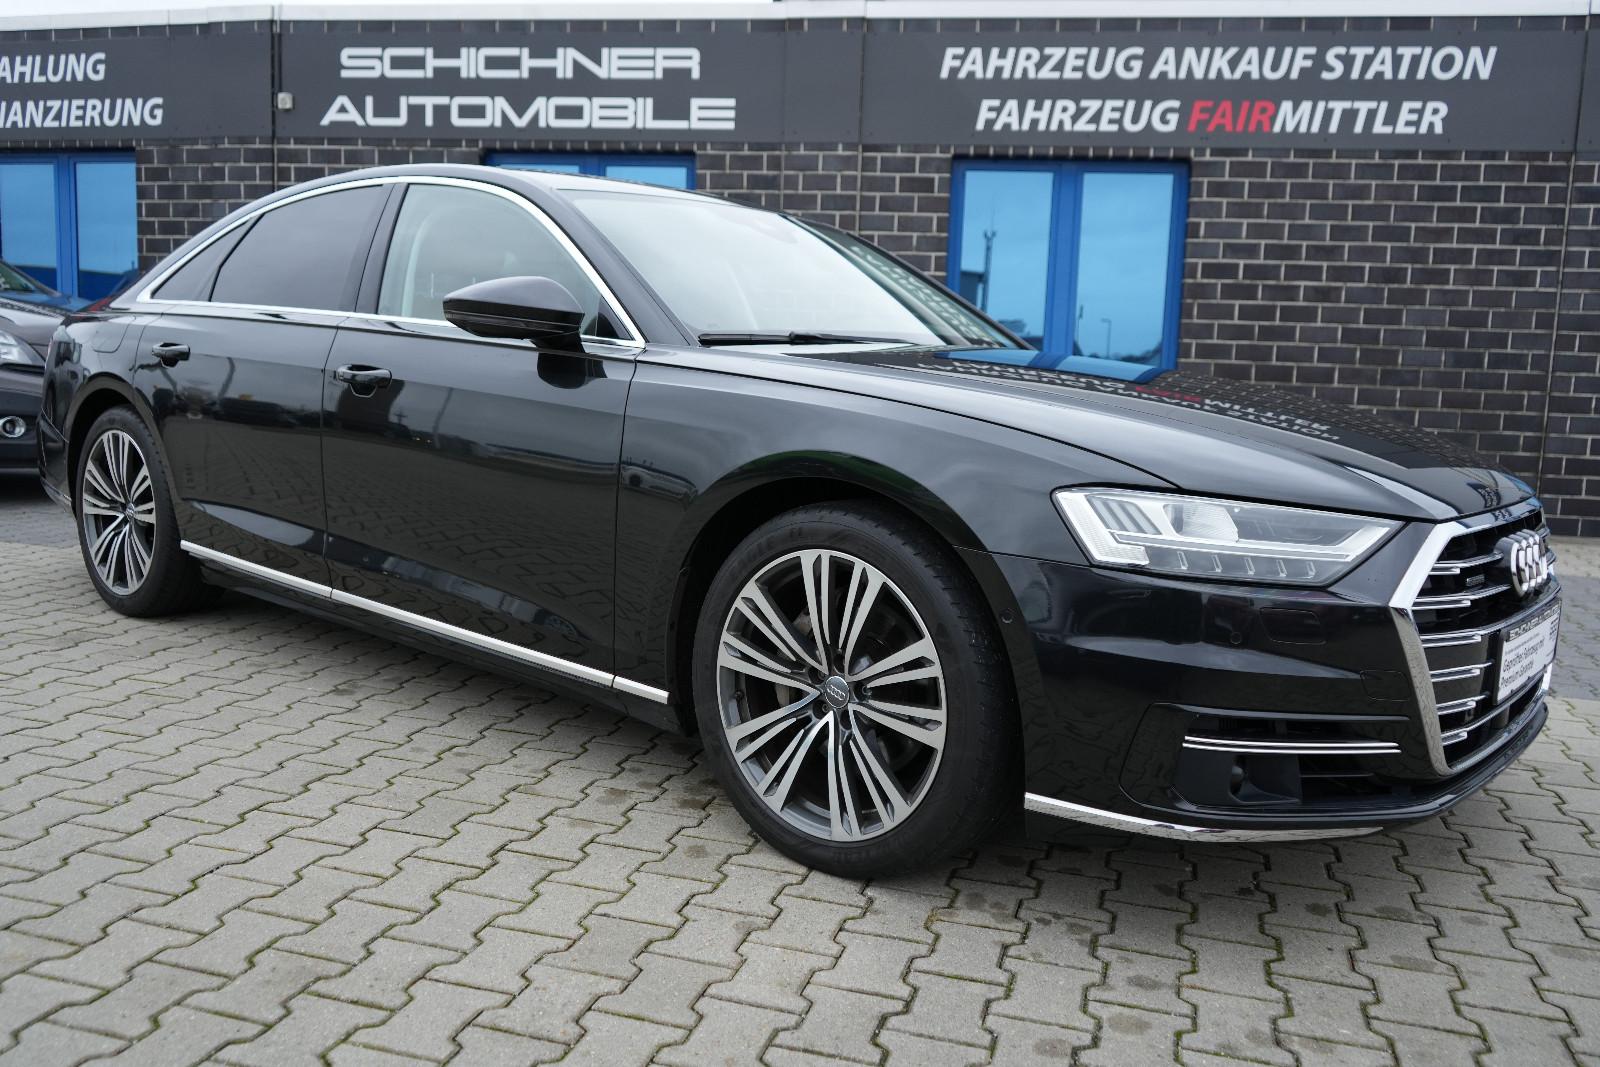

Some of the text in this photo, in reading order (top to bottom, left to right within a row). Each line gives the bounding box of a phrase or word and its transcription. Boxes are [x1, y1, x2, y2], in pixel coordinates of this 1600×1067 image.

[341, 46, 701, 80] SCHICHNER
[939, 46, 1498, 81] FAHRZEUG ANKAUF STATION
[320, 95, 737, 130] AUTOMOBILE
[975, 98, 1449, 135] FAHRZEUG FAIRMITTLER
